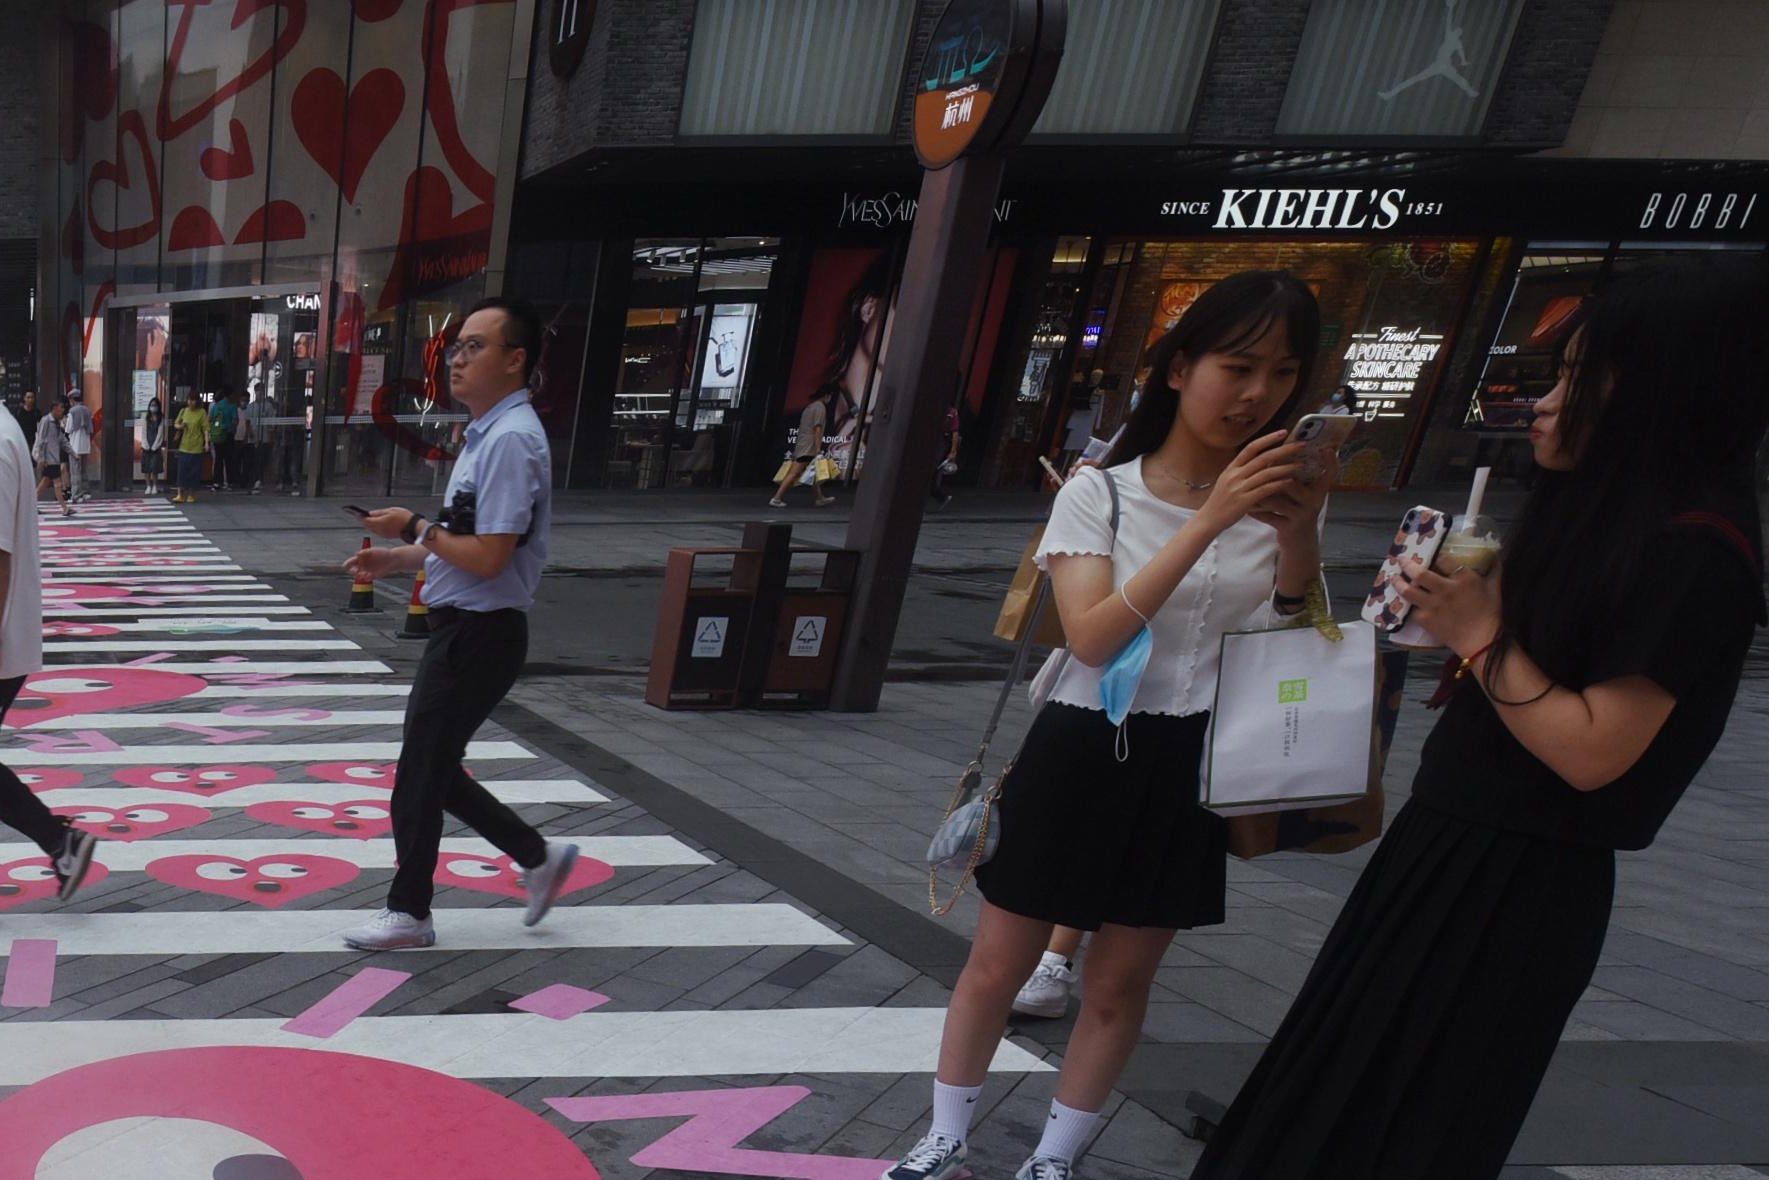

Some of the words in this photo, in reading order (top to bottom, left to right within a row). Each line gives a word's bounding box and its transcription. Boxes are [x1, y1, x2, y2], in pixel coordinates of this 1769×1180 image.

[941, 95, 975, 129] 杭州
[1160, 202, 1210, 215] SINCE
[1406, 202, 1444, 215] 1851
[1639, 193, 1757, 229] BOBBI
[1378, 326, 1422, 343] Finest
[1343, 343, 1441, 361] APOTHECARY
[1349, 361, 1423, 379] SKINCARE
